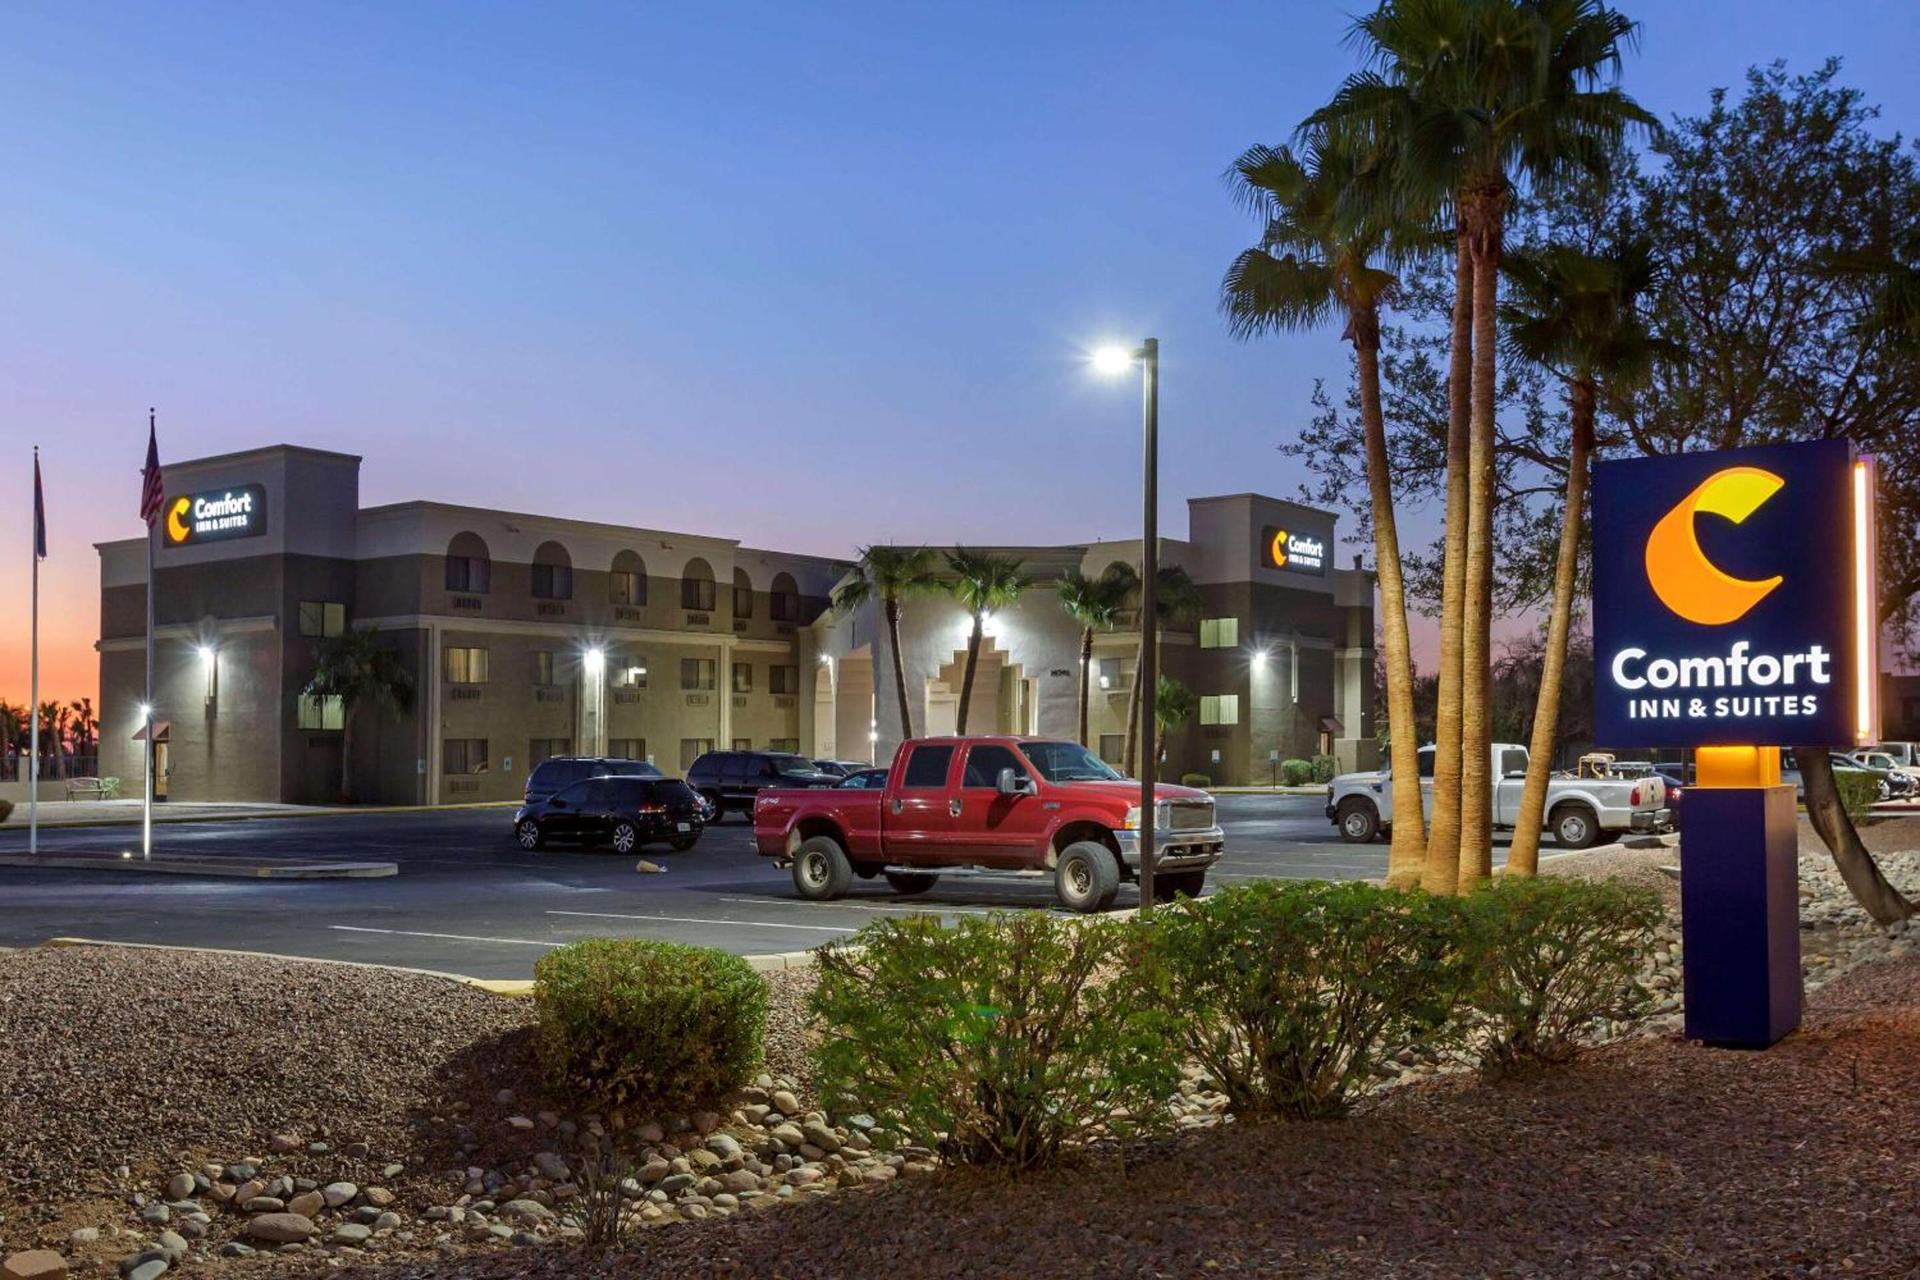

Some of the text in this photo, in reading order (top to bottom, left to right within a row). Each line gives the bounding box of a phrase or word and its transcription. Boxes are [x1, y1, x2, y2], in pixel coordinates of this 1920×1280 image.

[195, 492, 251, 519] Comfort
[219, 515, 247, 529] SUITES
[1288, 535, 1323, 557] Comfort
[1612, 641, 1831, 689] Comfort
[1629, 696, 1817, 718] INN & SUITES
